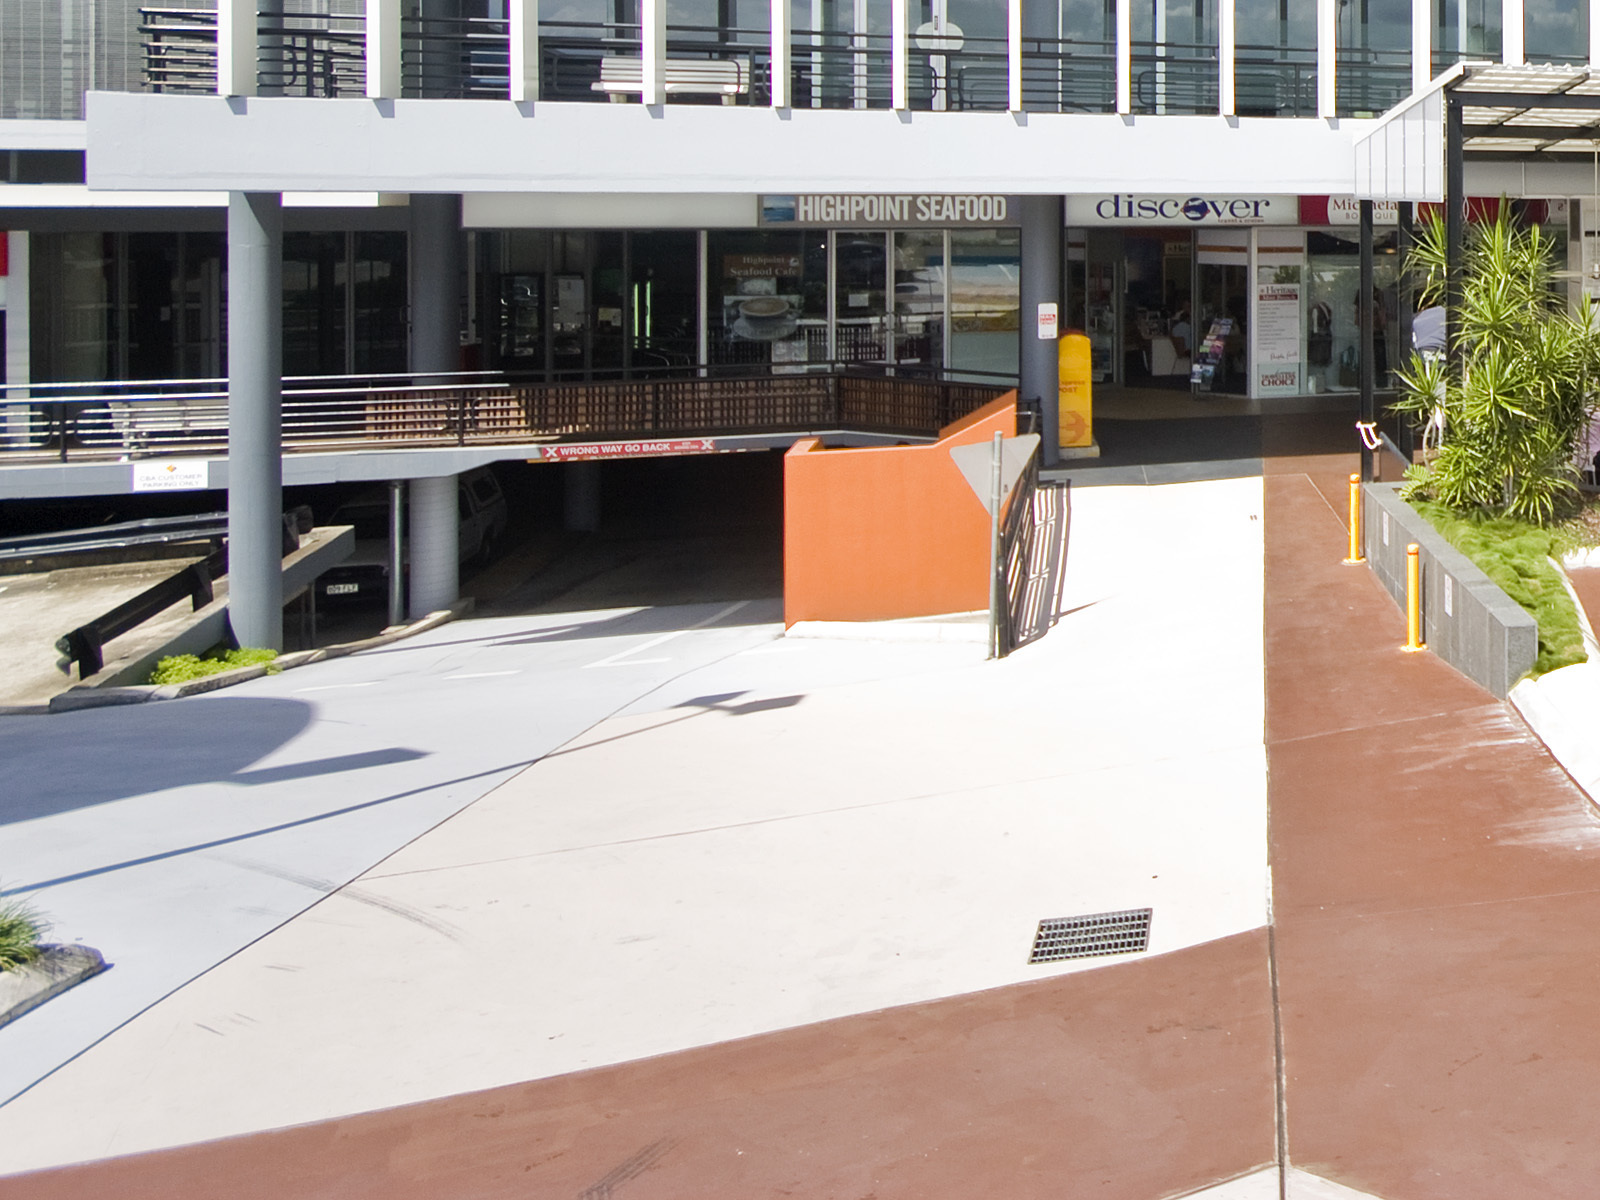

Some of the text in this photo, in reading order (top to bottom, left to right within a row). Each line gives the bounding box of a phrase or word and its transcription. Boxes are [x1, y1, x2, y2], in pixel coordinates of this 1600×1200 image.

[799, 195, 1007, 222] HIGHPOINT SEAFOOD
[1095, 194, 1271, 221] discover
[742, 255, 785, 265] Highpoint
[730, 267, 773, 276] Seafood
[1261, 379, 1296, 387] CHOICE
[560, 446, 599, 456] WRONG
[600, 444, 623, 453] WAY
[624, 443, 641, 452] GO
[642, 442, 671, 452] BACK
